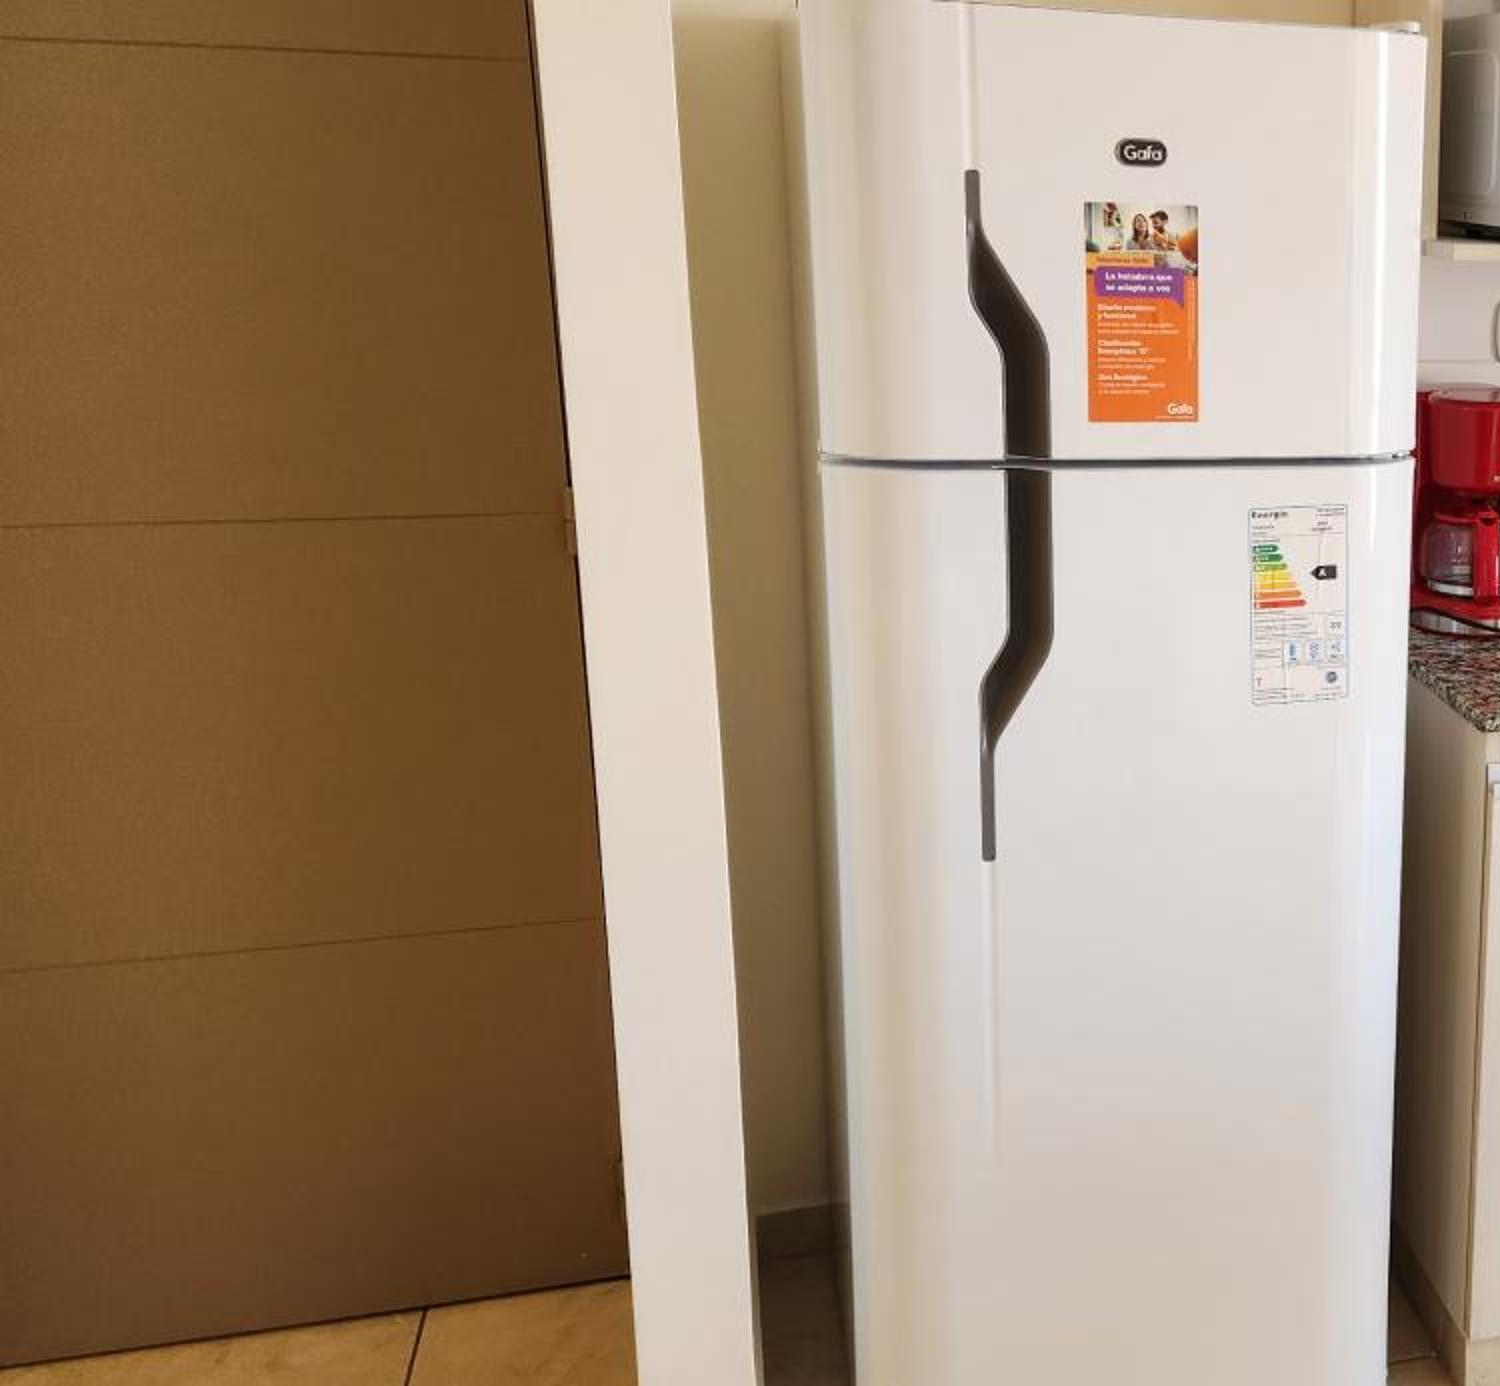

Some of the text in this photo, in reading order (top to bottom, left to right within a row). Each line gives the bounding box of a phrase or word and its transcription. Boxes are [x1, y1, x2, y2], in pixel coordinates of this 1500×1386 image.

[1123, 144, 1163, 161] Gafa
[1105, 271, 1116, 281] La
[1167, 402, 1193, 416] Gafa
